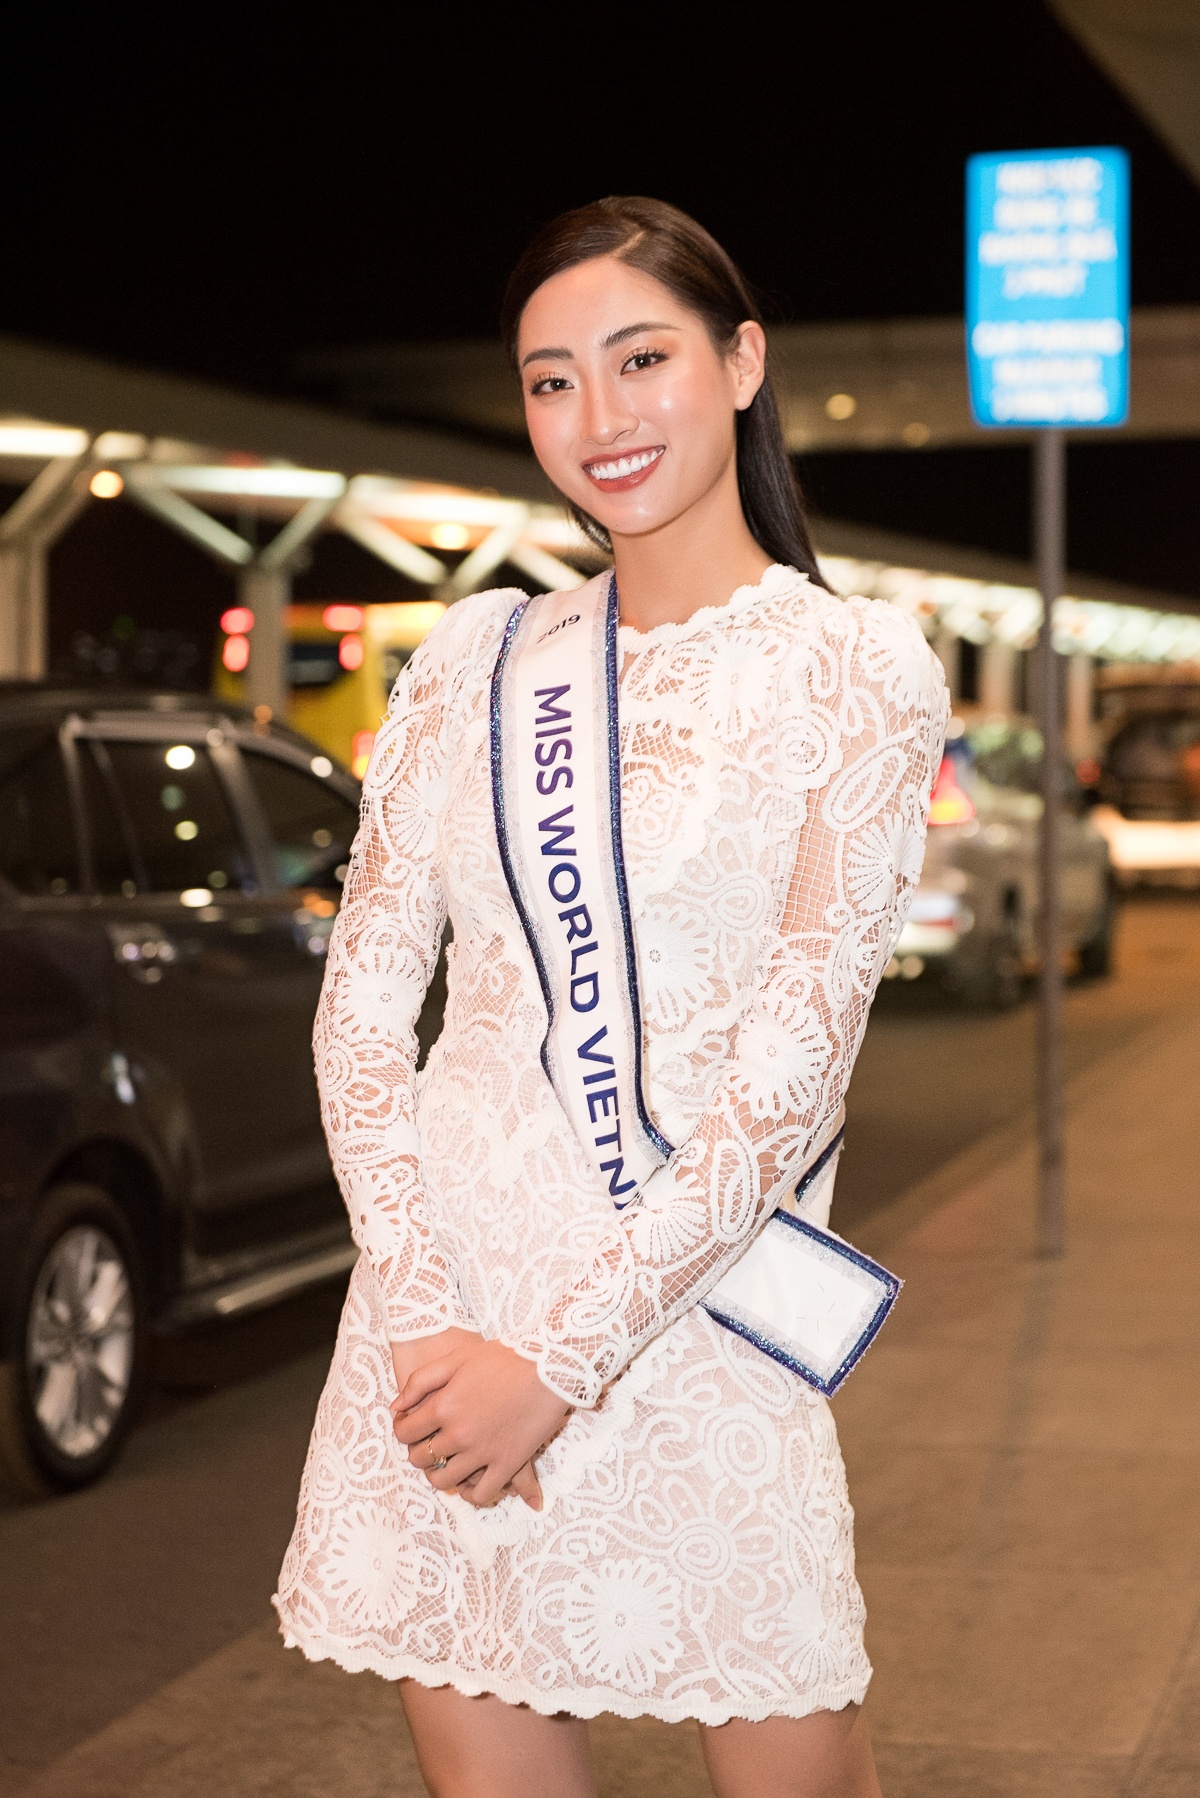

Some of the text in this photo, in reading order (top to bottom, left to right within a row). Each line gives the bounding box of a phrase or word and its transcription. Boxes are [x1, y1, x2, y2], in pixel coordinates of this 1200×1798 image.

[536, 614, 581, 644] 2019
[534, 683, 638, 1211] MISS WORLD VIETN
